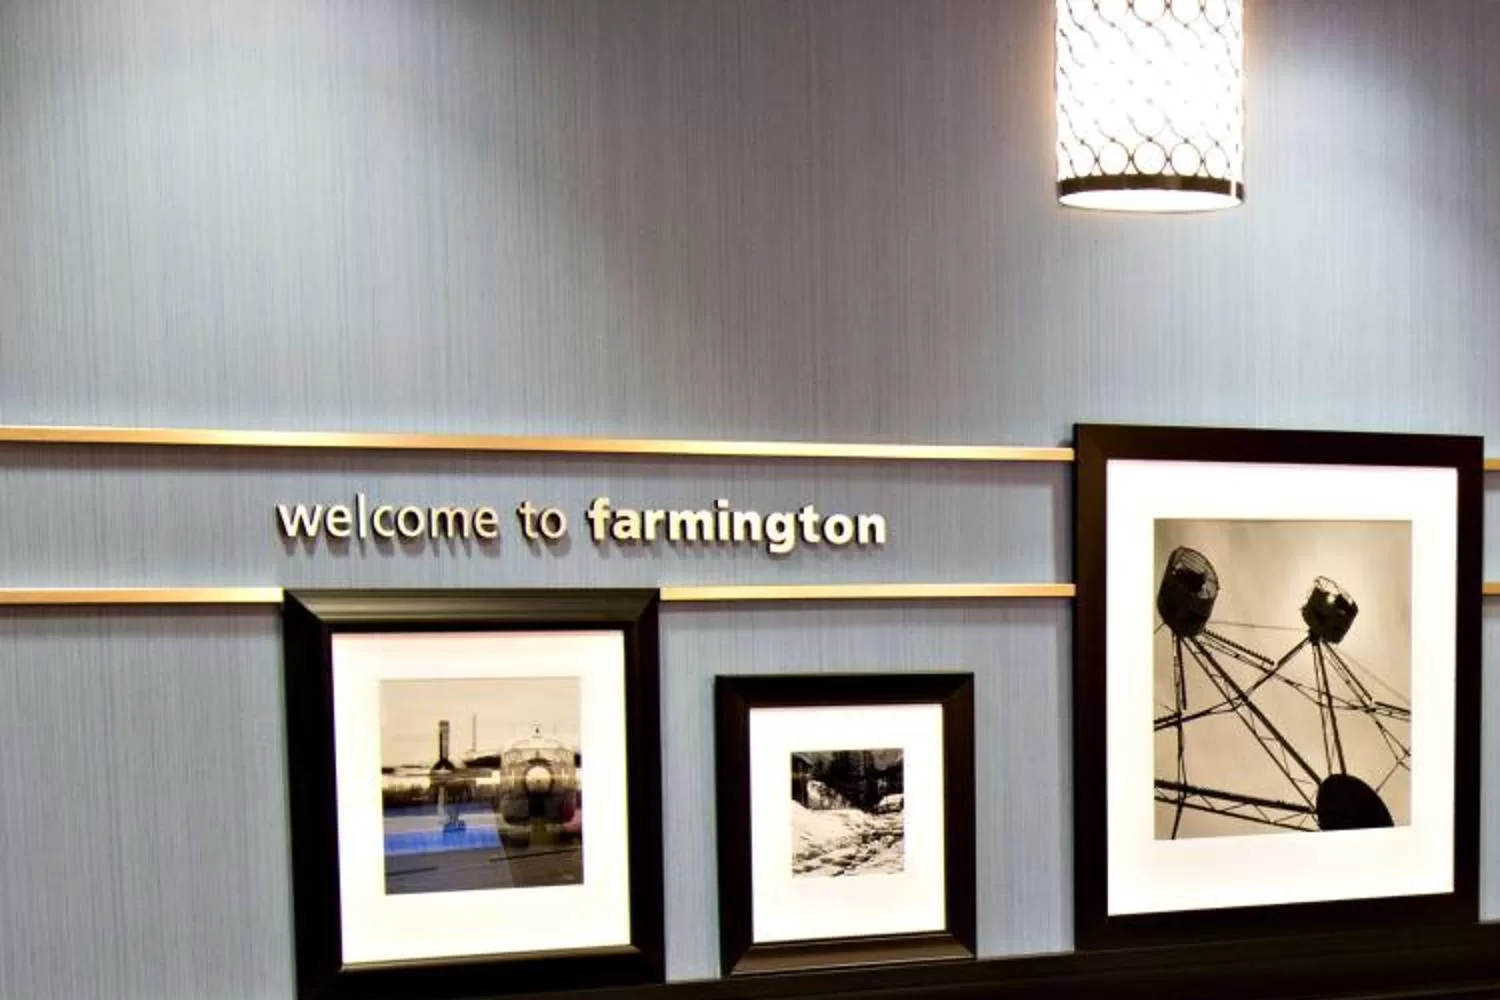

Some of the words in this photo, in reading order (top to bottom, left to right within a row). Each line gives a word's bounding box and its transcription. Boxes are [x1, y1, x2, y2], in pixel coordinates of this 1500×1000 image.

[277, 491, 498, 539] welcome
[517, 500, 567, 540] to
[587, 497, 886, 554] farmington
